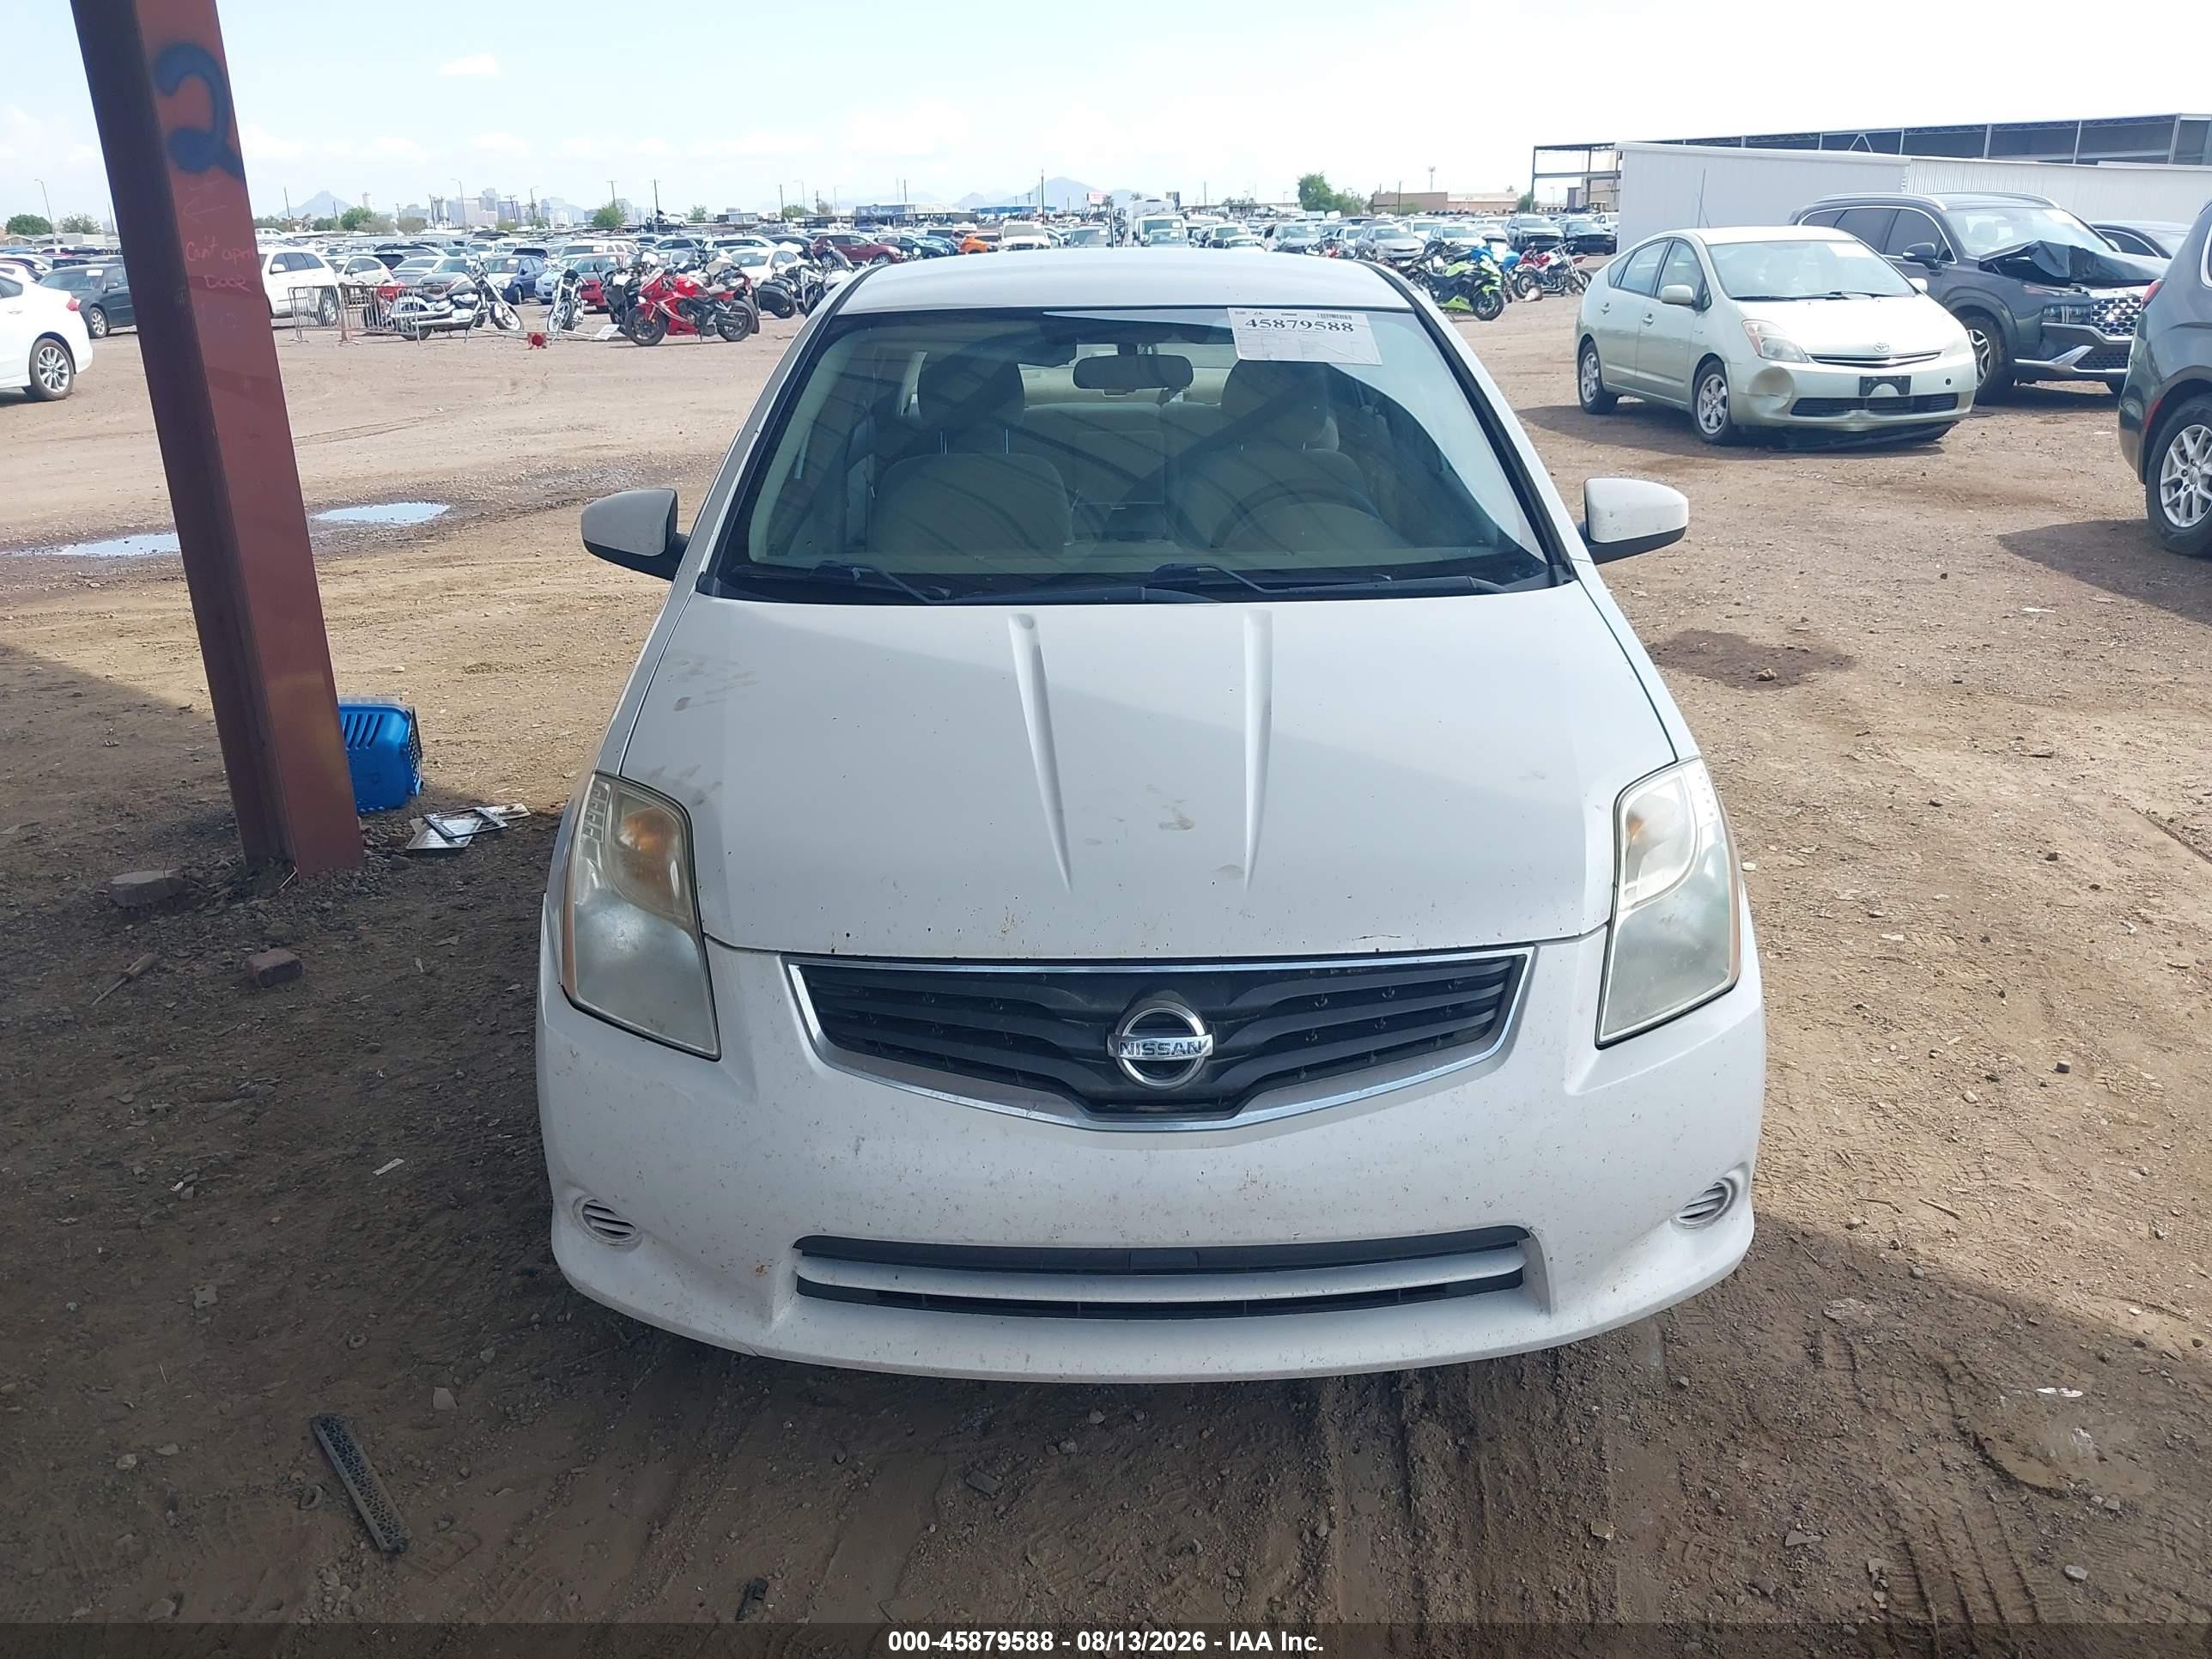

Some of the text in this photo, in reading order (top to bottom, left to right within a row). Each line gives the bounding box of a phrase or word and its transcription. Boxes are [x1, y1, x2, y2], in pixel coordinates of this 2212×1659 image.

[153, 40, 247, 179] 2
[1245, 318, 1354, 333] 45879588
[1119, 1040, 1202, 1056] NISSAN
